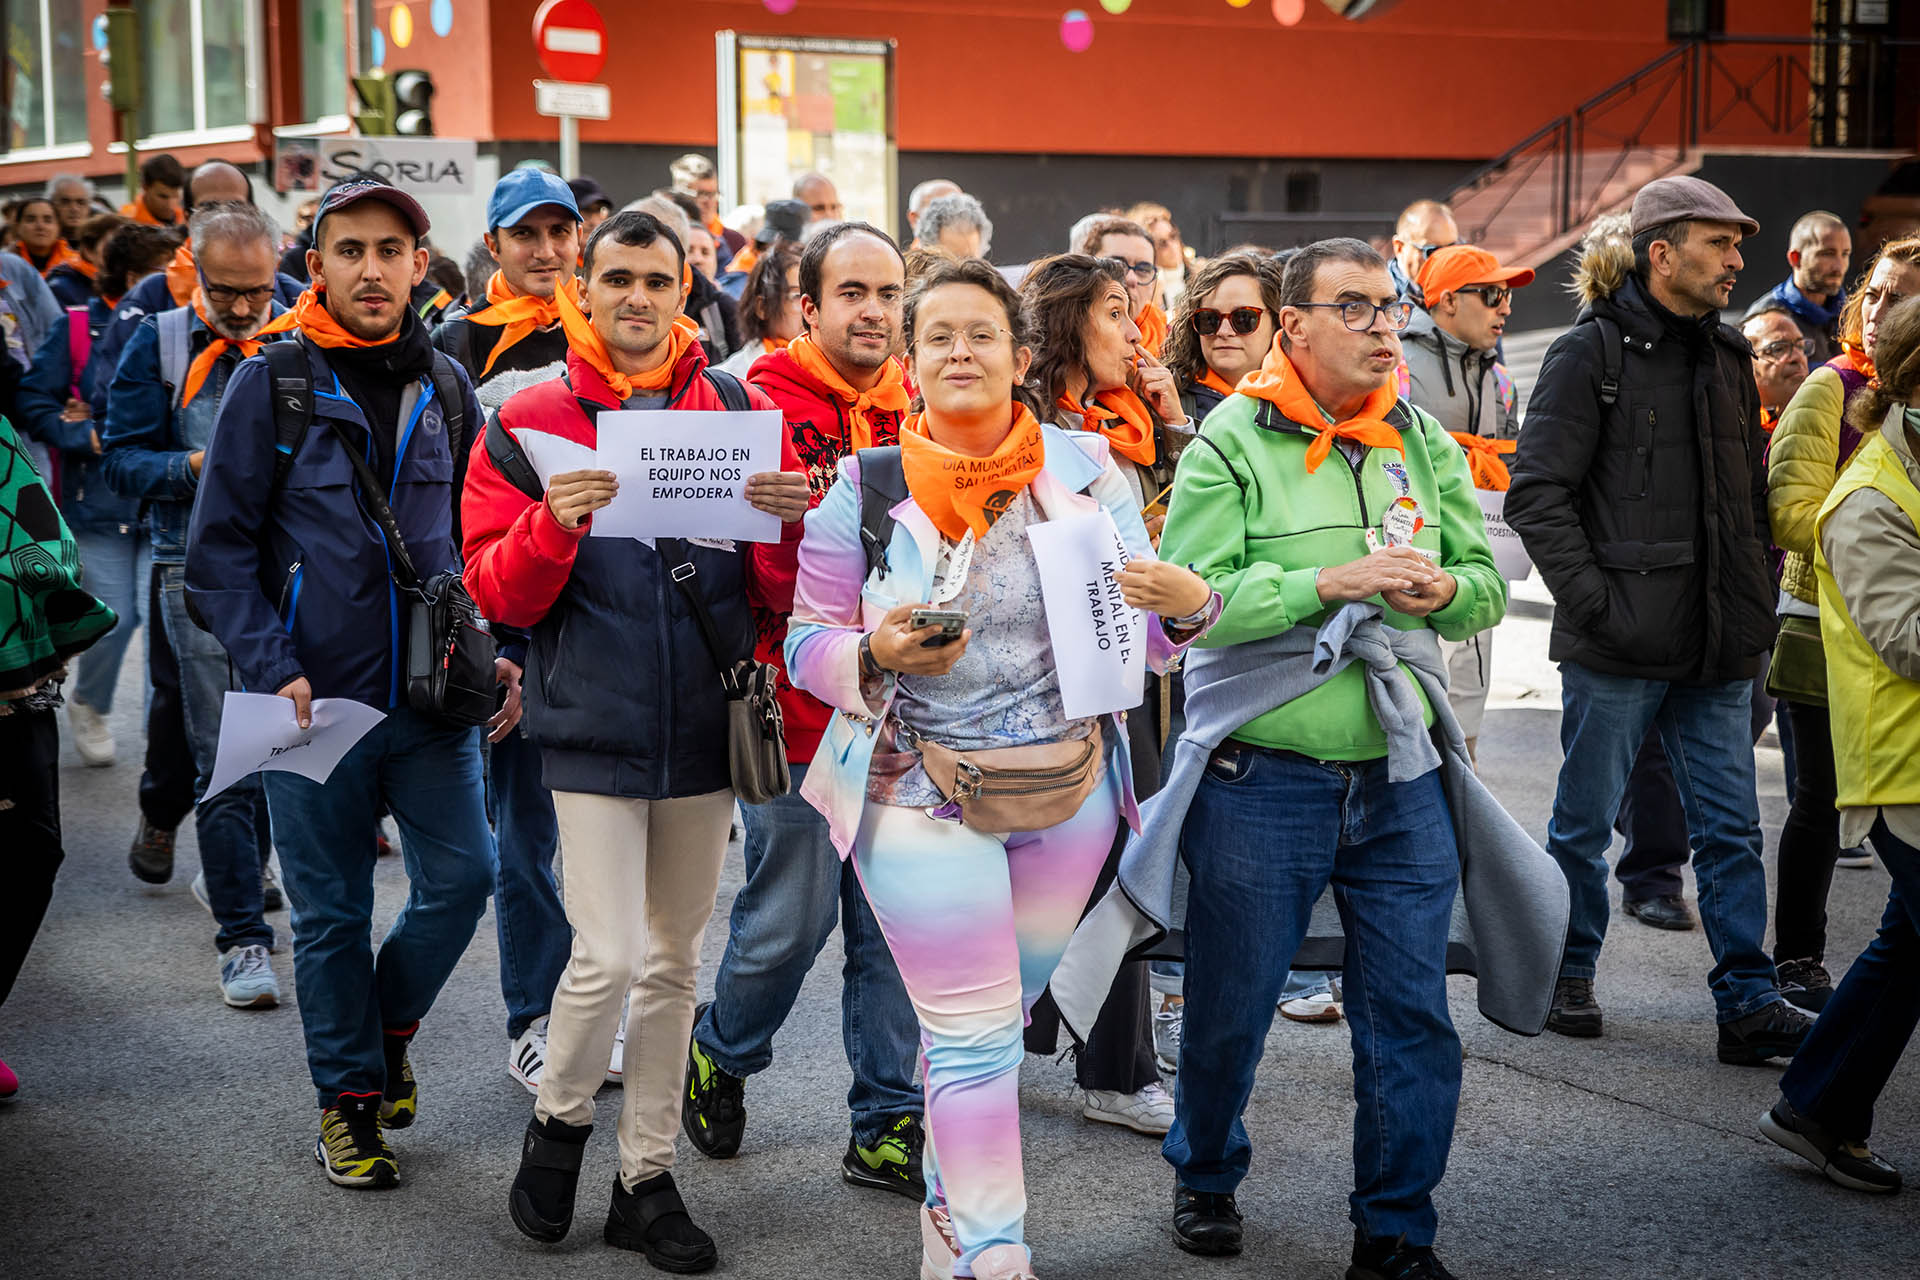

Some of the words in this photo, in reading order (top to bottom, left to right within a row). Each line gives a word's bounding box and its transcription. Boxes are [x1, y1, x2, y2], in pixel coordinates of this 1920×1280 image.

[321, 150, 464, 185] SORIA
[641, 448, 655, 461] EL
[660, 448, 727, 461] TRABAJO
[732, 448, 750, 461] EN
[648, 468, 705, 482] EQUIPO
[709, 468, 741, 481] NOS
[652, 487, 733, 499] EMPODERA
[1483, 513, 1504, 523] TRAB
[1101, 561, 1125, 621] MENTAL
[1115, 623, 1130, 644] EN
[1086, 580, 1111, 651] TRABAJO
